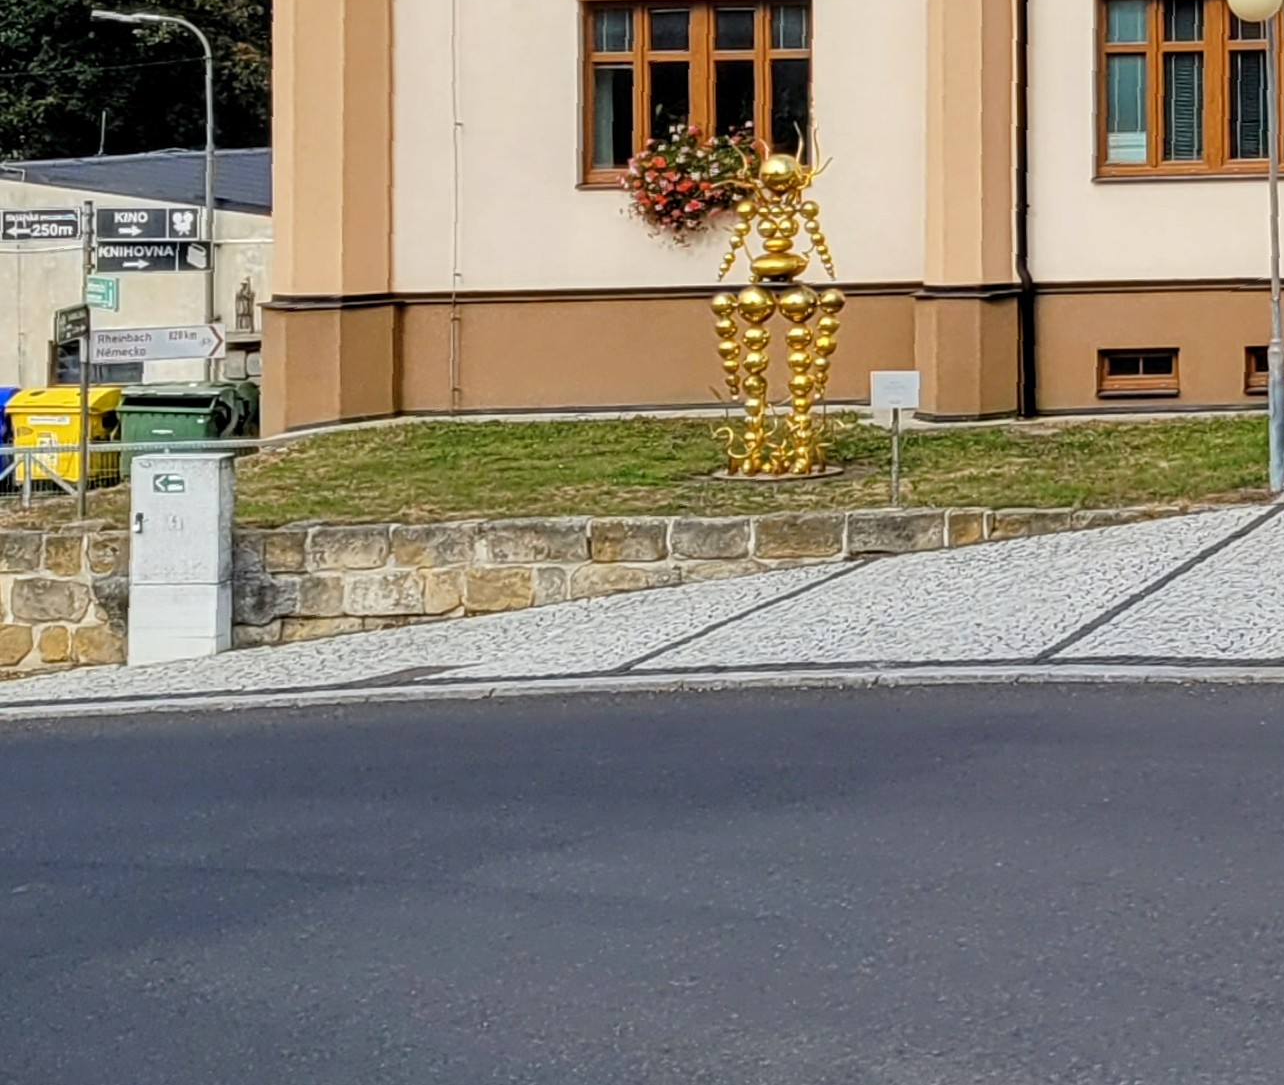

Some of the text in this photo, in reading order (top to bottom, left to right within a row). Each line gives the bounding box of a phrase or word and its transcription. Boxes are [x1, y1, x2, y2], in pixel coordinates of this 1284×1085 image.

[114, 211, 149, 224] KINO
[31, 223, 74, 237] 250m
[98, 245, 175, 258] KNIHOVNA
[97, 332, 153, 345] Rheinbach
[96, 345, 147, 358] Německo
